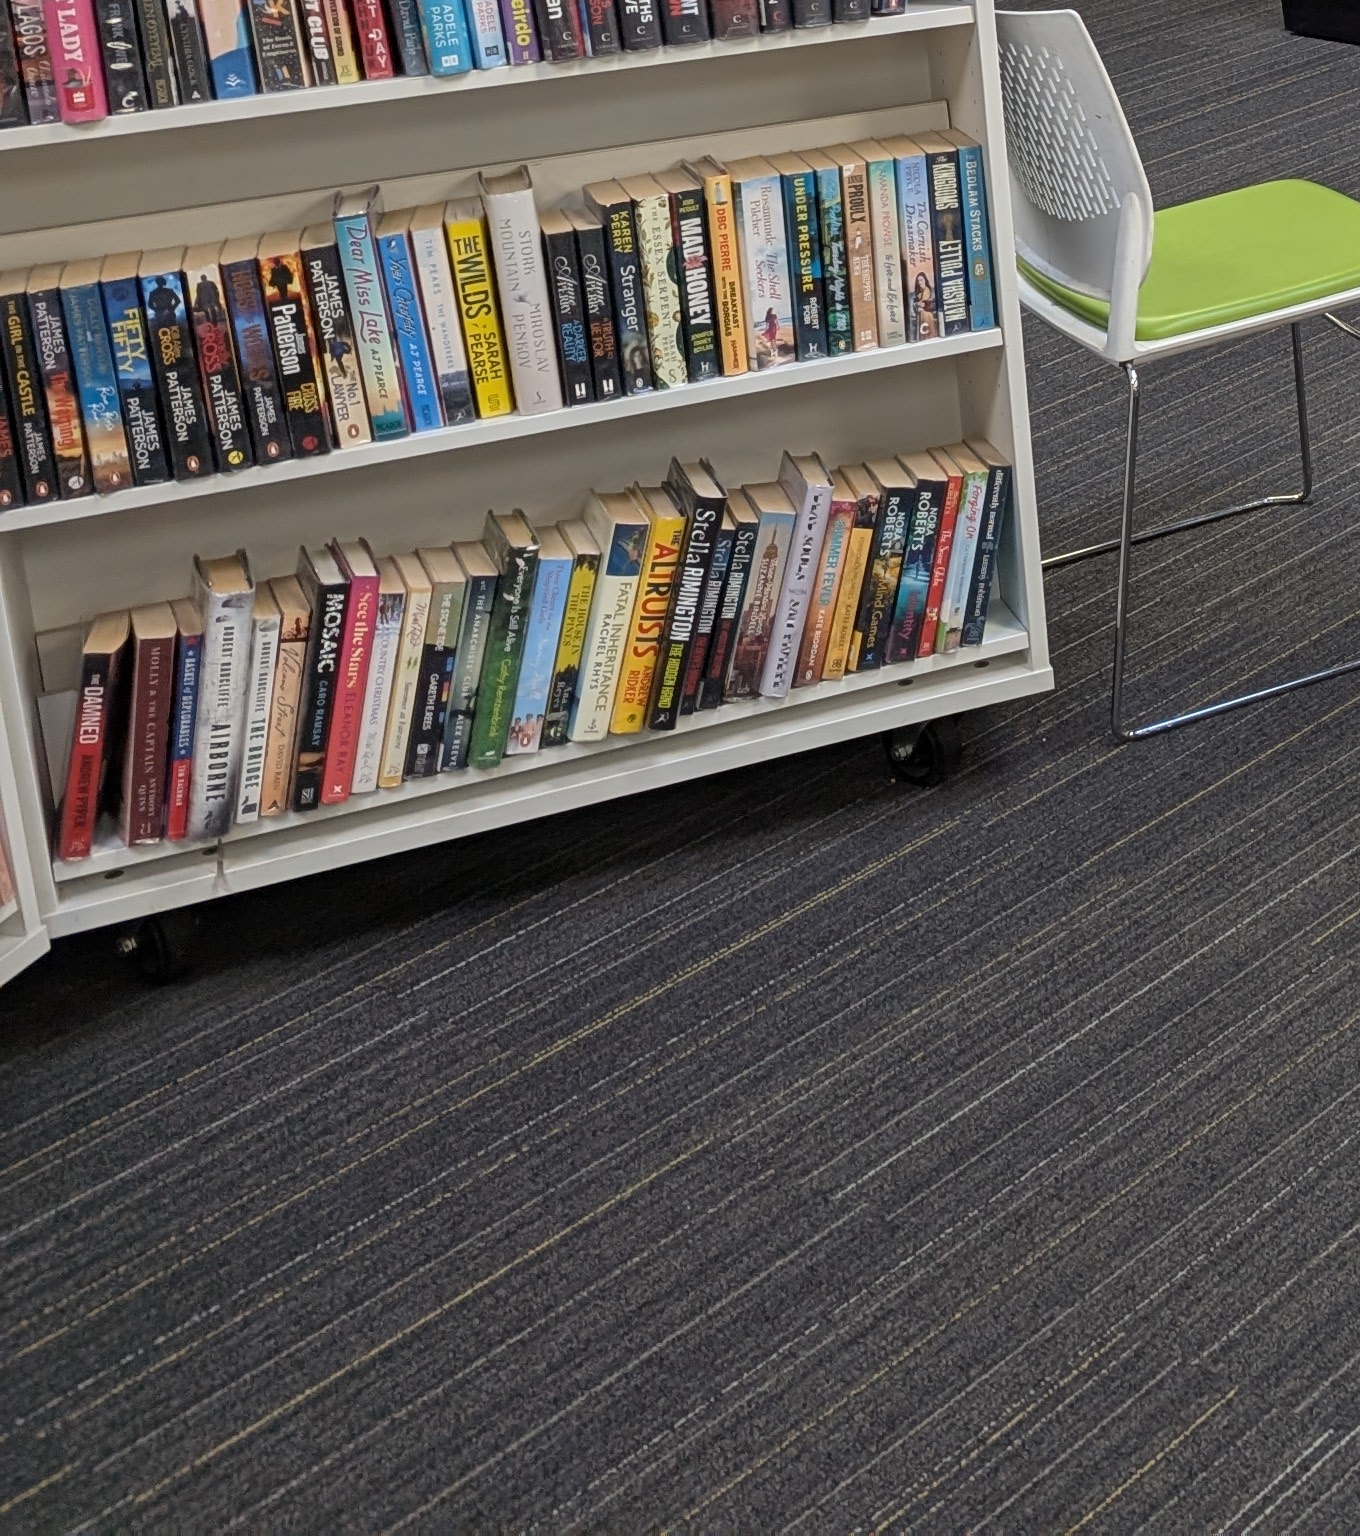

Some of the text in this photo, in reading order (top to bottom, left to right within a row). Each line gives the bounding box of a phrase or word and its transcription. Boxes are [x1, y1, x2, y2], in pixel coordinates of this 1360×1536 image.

[57, 7, 84, 63] LADY
[430, 6, 447, 48] PARKS
[441, 4, 460, 47] ADELE
[609, 213, 624, 254] PERRY
[617, 210, 634, 254] KAREN
[792, 176, 814, 293] UNDER PRESSURE
[453, 234, 492, 321] THE WILDS
[619, 264, 640, 333] Stranger
[34, 301, 57, 371] PATTERSON
[48, 314, 66, 355] JAMES
[123, 307, 147, 361] FIFTY
[271, 303, 301, 376] Patterson
[469, 332, 490, 386] PEARSE
[482, 331, 503, 381] SARAH
[23, 421, 41, 475] PATTERSON
[34, 431, 48, 463] JAMES
[879, 496, 901, 557] ROBERTS
[893, 511, 906, 548] NORA
[911, 491, 932, 551] ROBERTS
[924, 506, 939, 537] NORA
[632, 528, 682, 660] THE ALTRUISTS
[721, 530, 755, 620] Stella RIMINGTON
[588, 613, 613, 691] RACHEL RHYS
